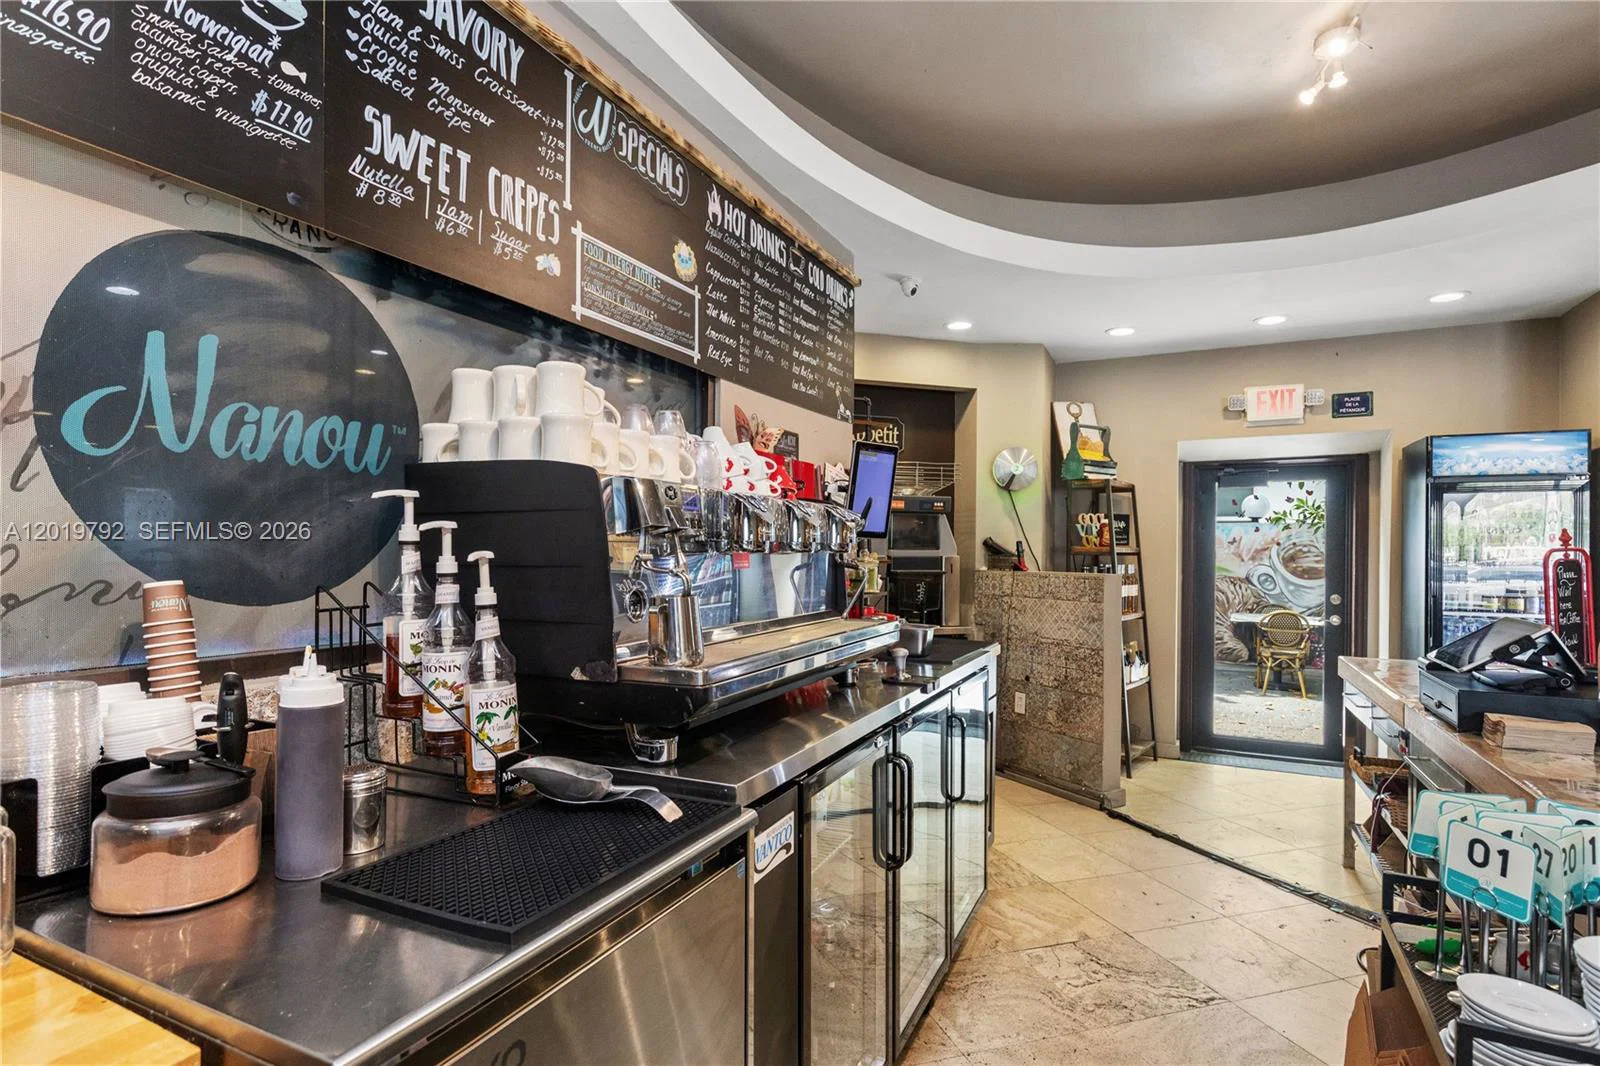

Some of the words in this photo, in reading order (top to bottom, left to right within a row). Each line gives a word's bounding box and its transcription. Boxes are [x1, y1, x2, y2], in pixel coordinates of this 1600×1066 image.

[131, 3, 194, 45] Smoked
[360, 13, 418, 63] Quiche
[206, 57, 233, 78] red
[362, 0, 404, 32] Ham
[408, 25, 423, 42] &
[474, 67, 544, 121] Croissant
[131, 70, 207, 112] balsamic
[206, 86, 220, 99] &
[357, 59, 415, 101] Salted
[427, 98, 472, 134] Crêpe
[358, 36, 417, 81] Croque
[427, 77, 496, 128] Monsieur
[250, 89, 313, 138] $17.90
[363, 104, 471, 203] SWEET
[487, 166, 560, 245] CREPES
[618, 121, 684, 198] SPECIALS
[349, 154, 415, 199] Nutella
[437, 196, 474, 226] Jam
[491, 220, 532, 253] Sugar
[724, 200, 746, 241] HOT
[750, 218, 787, 268] DRINKS
[583, 241, 604, 260] FOOD
[606, 252, 634, 277] ALLERGY
[706, 283, 728, 303] Latte
[705, 326, 738, 348] Americano
[707, 344, 720, 361] Red
[719, 351, 733, 368] Eye
[60, 330, 391, 476] Nanou
[1256, 389, 1296, 416] EXIT
[423, 664, 462, 673] MONIN
[756, 823, 793, 864] VANTCO
[1467, 838, 1510, 878] 01
[1532, 842, 1554, 878] 27
